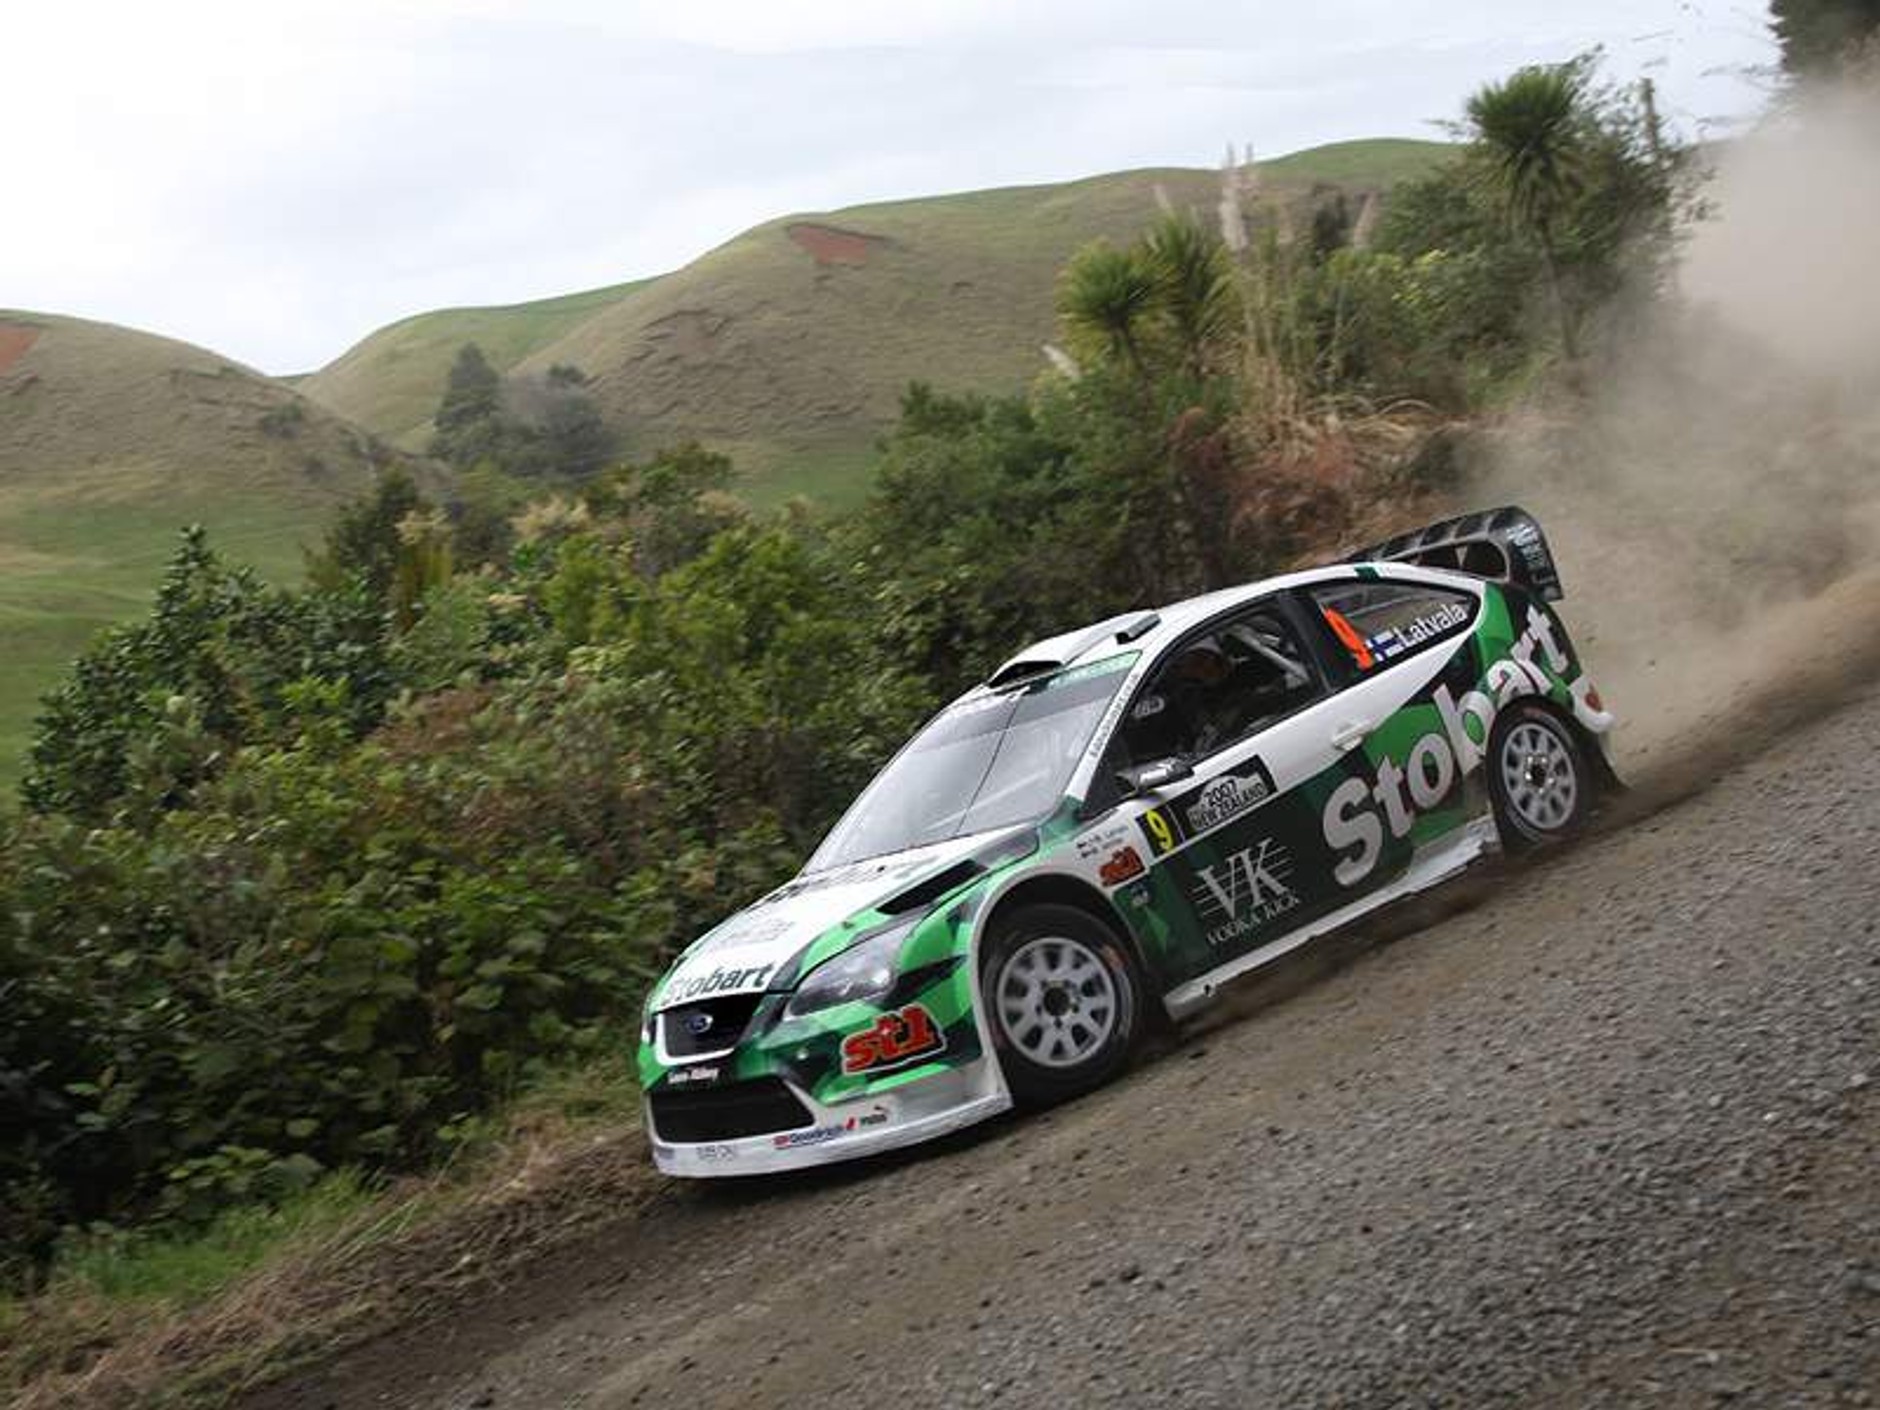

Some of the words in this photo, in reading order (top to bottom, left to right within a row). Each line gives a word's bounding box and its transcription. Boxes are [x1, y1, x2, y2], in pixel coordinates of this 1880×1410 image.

[1325, 609, 1374, 671] 9
[1394, 603, 1468, 648] Latvala
[1323, 604, 1568, 886] Stobart
[1203, 778, 1240, 808] 2007
[1146, 809, 1174, 851] 9
[1197, 837, 1291, 919] VK
[662, 963, 774, 1002] Stobart
